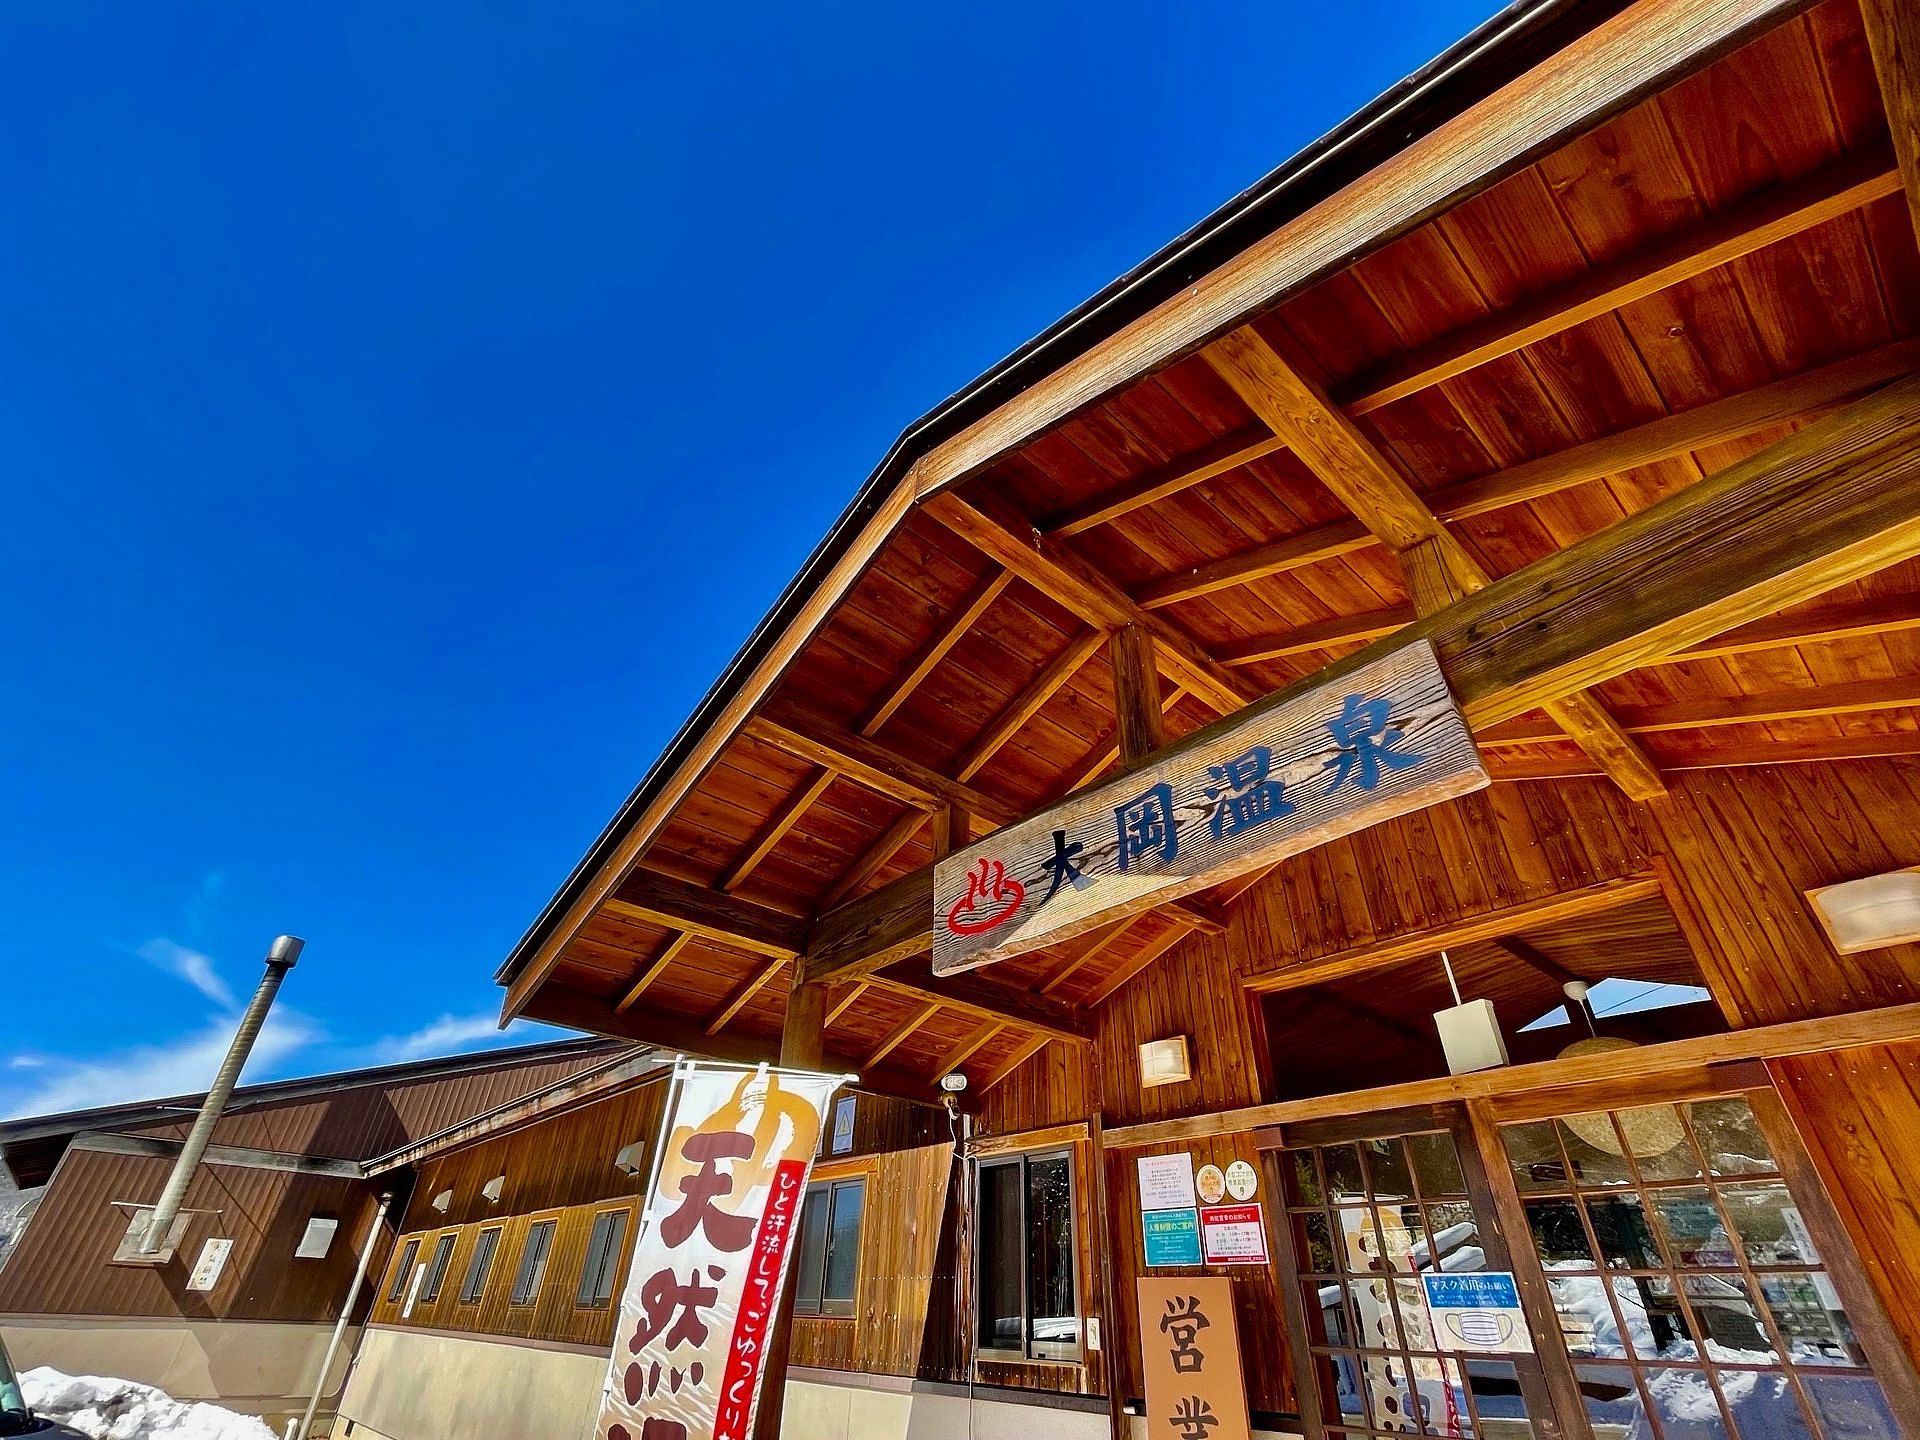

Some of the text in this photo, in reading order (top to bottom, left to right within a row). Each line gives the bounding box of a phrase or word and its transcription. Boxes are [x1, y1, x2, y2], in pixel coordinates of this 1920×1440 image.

[1039, 693, 1426, 906] 大岡温泉
[607, 1131, 758, 1440] 天然
[715, 1172, 797, 1440] ひと汗流して、ごゆっくり
[1430, 1279, 1511, 1292] マスク着用のお願い
